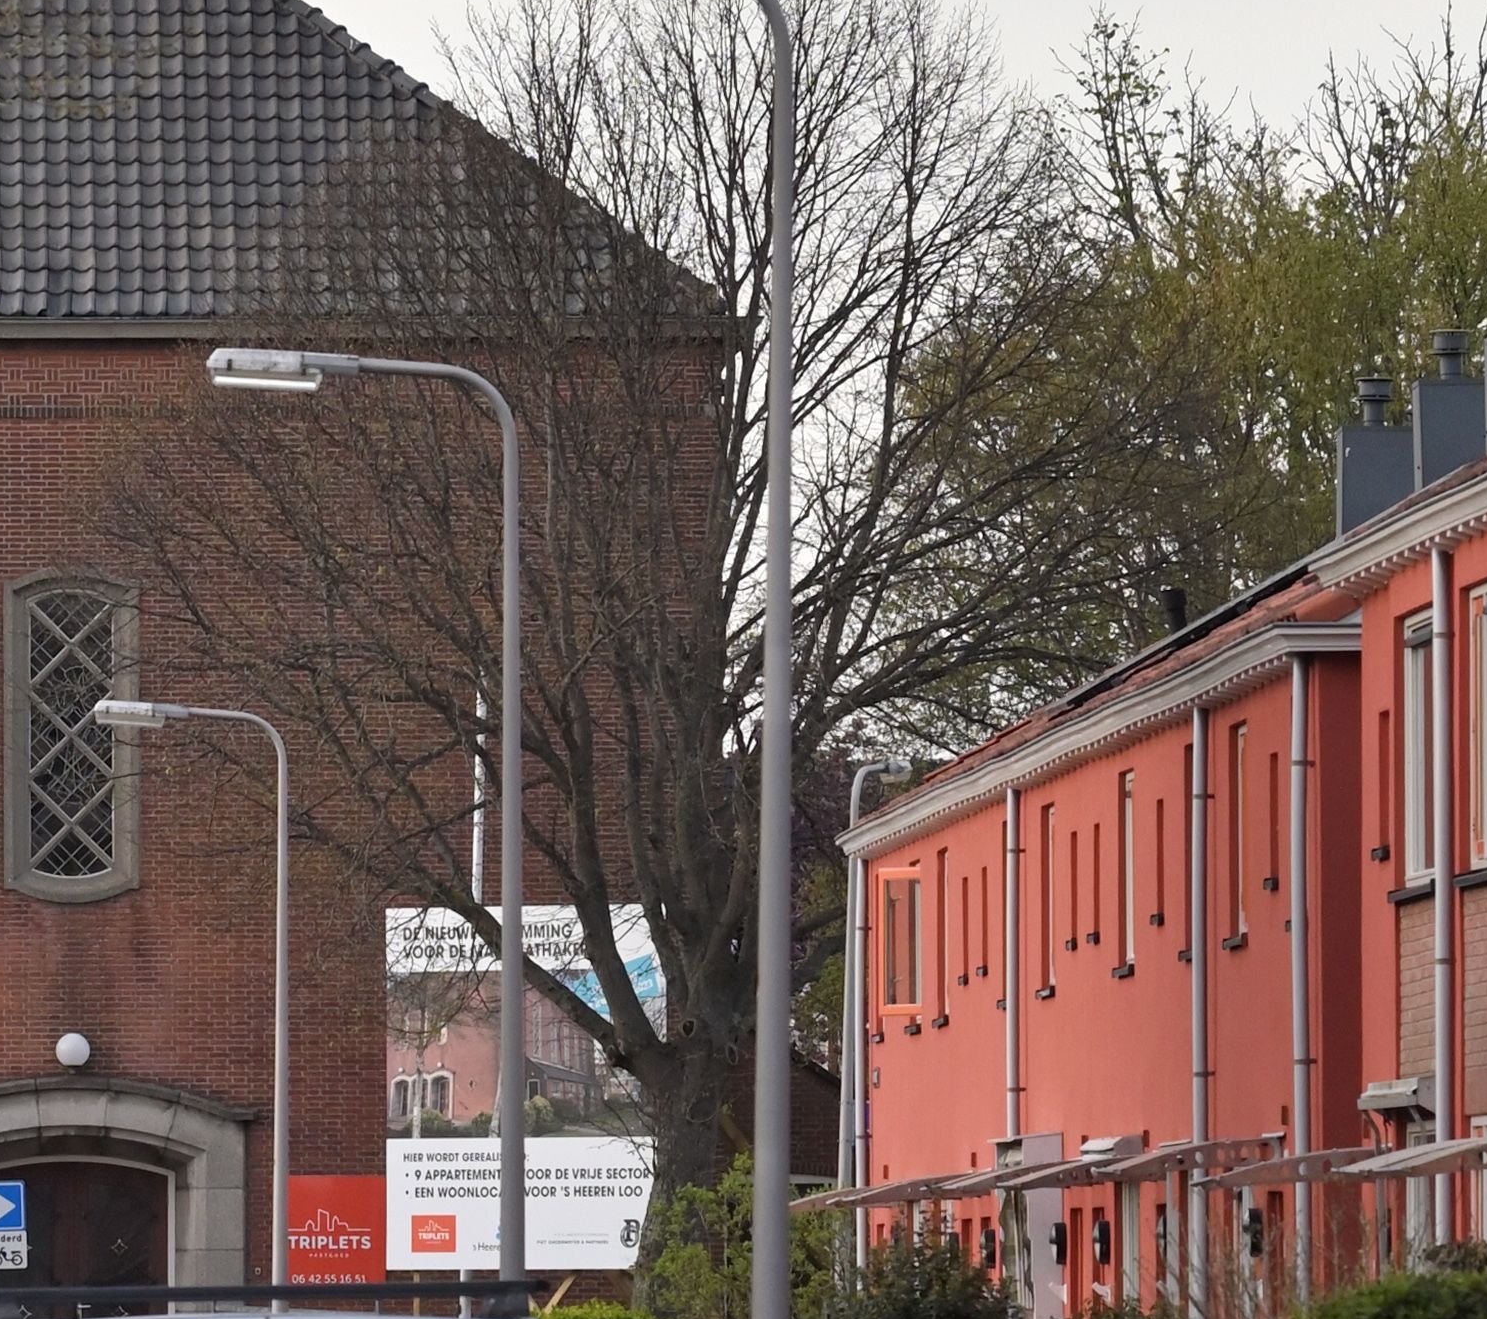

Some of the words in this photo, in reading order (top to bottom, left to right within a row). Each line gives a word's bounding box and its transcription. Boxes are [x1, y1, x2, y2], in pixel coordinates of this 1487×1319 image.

[403, 927, 420, 941] DE
[403, 945, 444, 959] VOOR
[450, 945, 466, 958] DE
[403, 1153, 424, 1162] HIER
[426, 1153, 459, 1162] WORDT
[415, 1169, 422, 1181] 9
[425, 1169, 501, 1181] APPARTEMENT
[526, 1168, 552, 1180] OOR
[555, 1168, 569, 1180] DE
[572, 1168, 603, 1180] VRIJE
[606, 1168, 649, 1180] SECTOR
[415, 1187, 434, 1198] EEN
[438, 1186, 502, 1198] WOONLOC
[574, 1186, 615, 1198] HEEREN
[619, 1185, 643, 1198] LOO
[288, 1235, 372, 1250] TRIPLETS
[291, 1274, 306, 1284] 06
[308, 1274, 322, 1284] 42
[324, 1274, 337, 1284] 55
[339, 1274, 352, 1284] 16
[354, 1274, 367, 1284] 51
